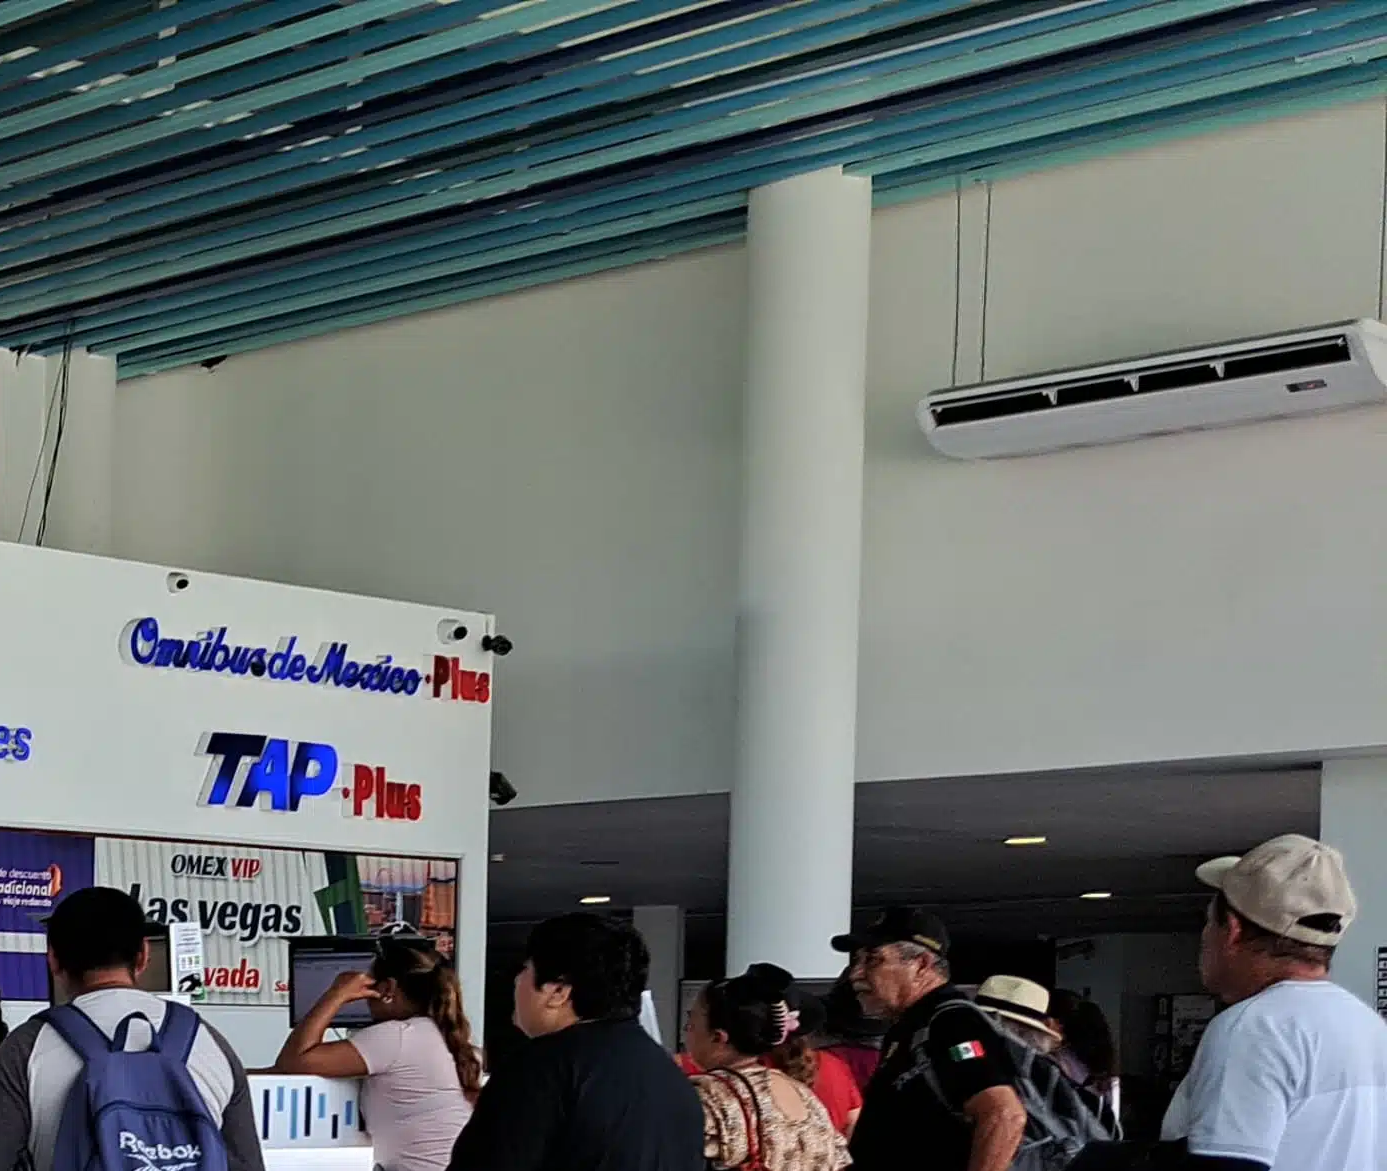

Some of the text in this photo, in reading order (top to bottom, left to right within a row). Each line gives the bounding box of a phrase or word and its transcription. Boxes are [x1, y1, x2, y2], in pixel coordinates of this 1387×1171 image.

[130, 617, 266, 677] Omnibus
[268, 635, 306, 681] de
[204, 731, 339, 813] TAP
[8, 868, 52, 880] descuento
[170, 854, 262, 878] OMEX VIP
[198, 899, 302, 942] vegas
[204, 958, 260, 989] vada
